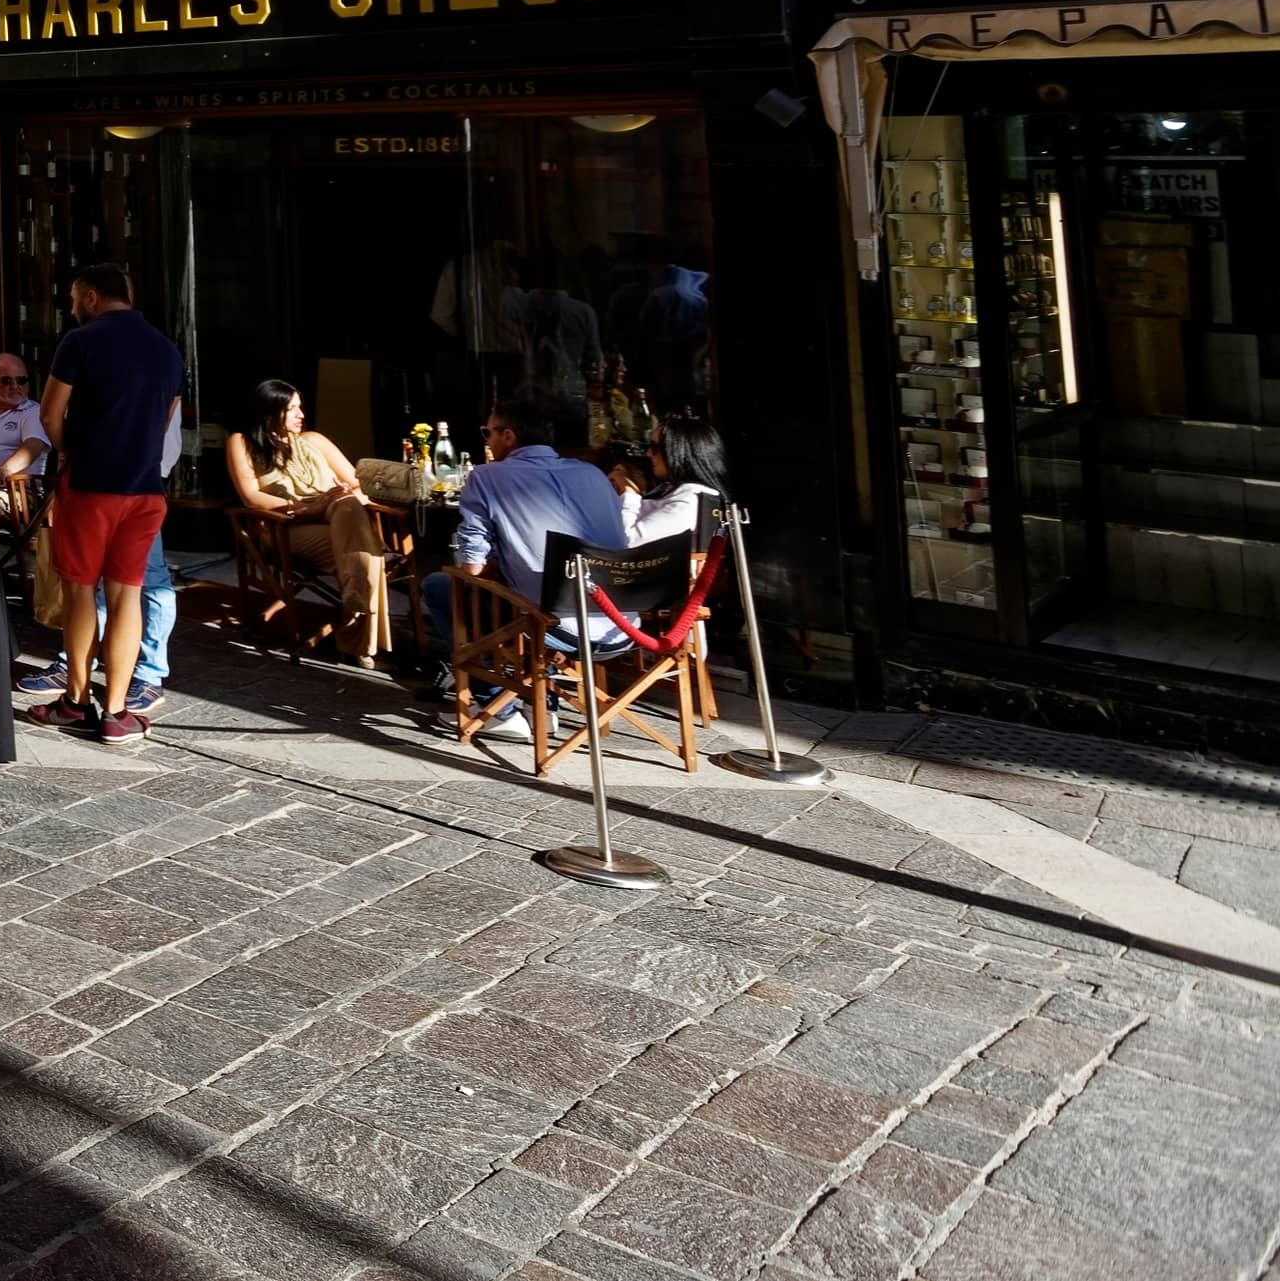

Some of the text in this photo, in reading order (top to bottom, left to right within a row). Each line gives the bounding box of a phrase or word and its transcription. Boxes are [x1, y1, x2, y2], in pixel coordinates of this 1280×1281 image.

[154, 92, 223, 109] WINES
[257, 86, 347, 106] SPIRITS
[387, 79, 538, 101] COCKTAILS
